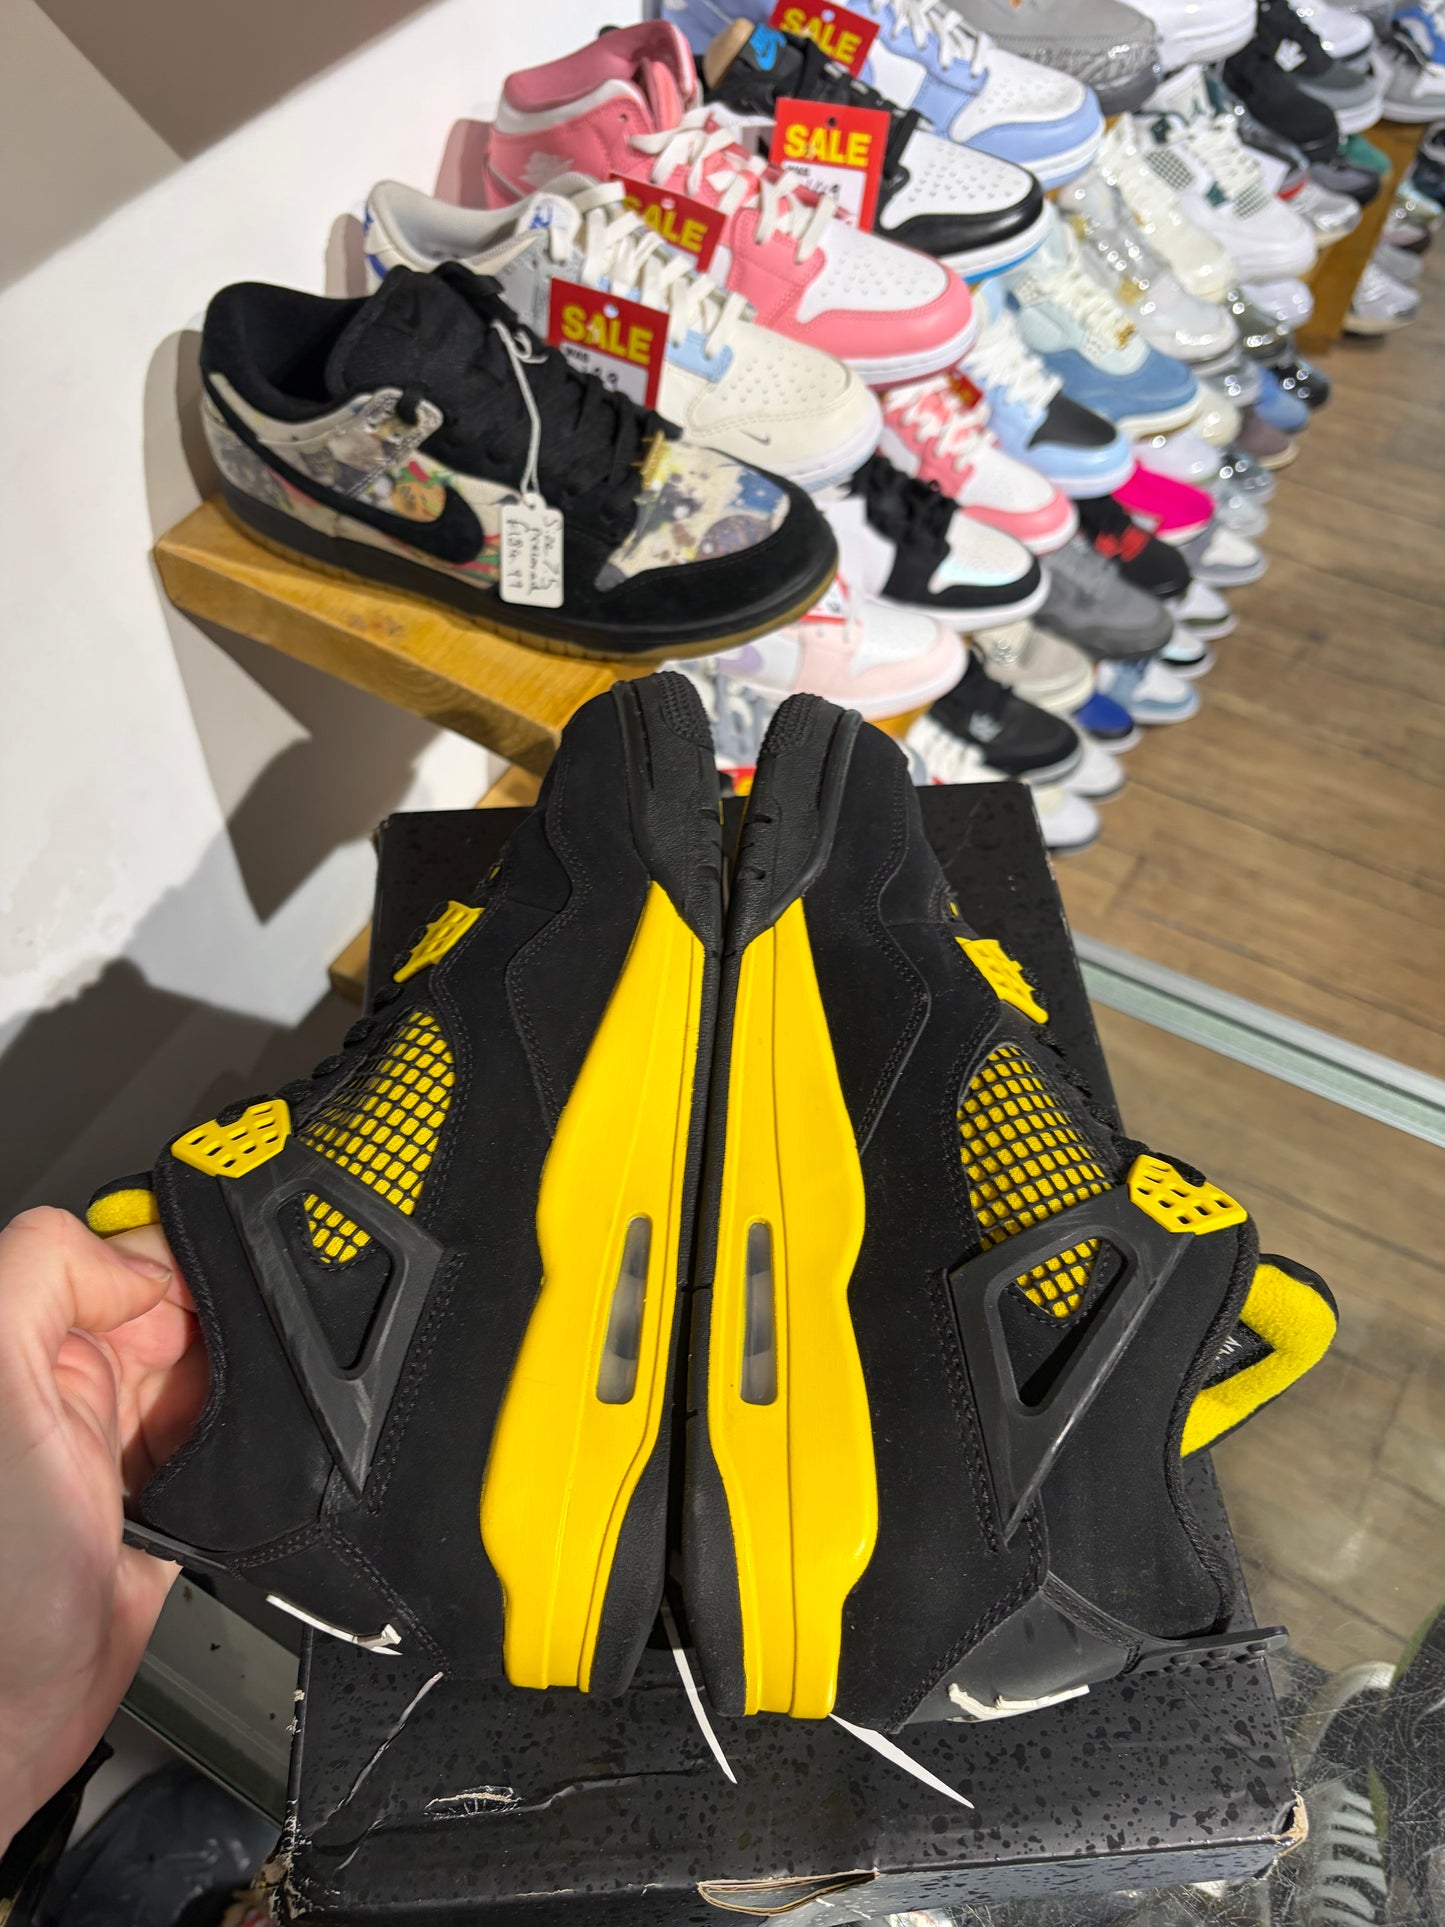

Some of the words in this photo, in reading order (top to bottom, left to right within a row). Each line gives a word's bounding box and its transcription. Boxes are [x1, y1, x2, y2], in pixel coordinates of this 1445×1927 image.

[779, 7, 862, 65] SALE
[783, 123, 873, 168] SALE
[561, 304, 653, 365] SALE
